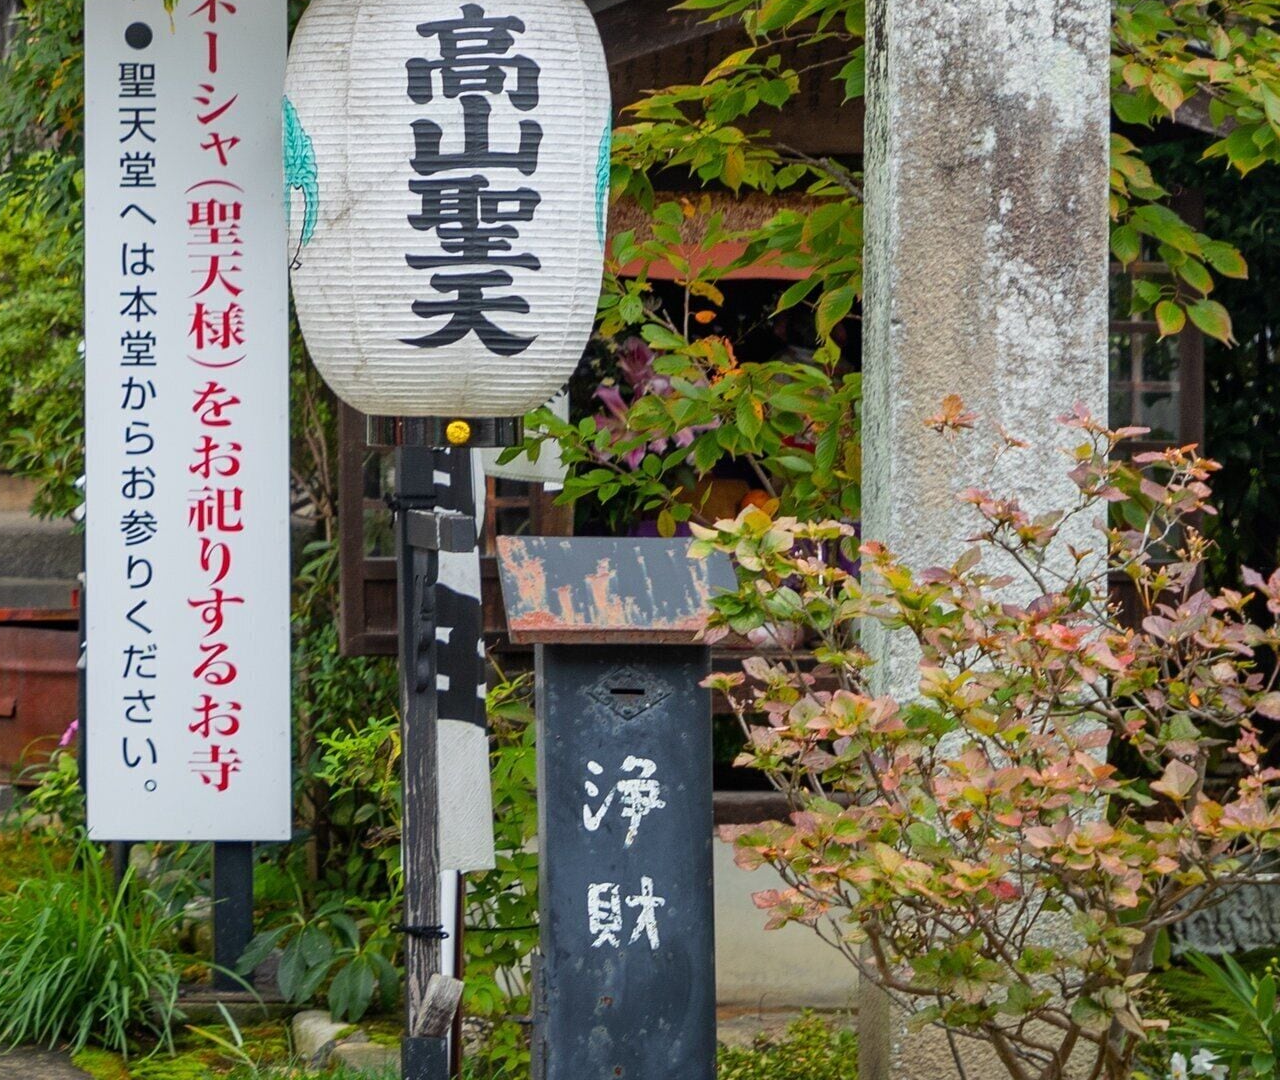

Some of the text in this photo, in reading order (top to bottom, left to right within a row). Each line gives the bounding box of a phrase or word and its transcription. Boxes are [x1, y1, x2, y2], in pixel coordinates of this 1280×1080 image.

[398, 3, 543, 356] 高山聖天
[583, 755, 667, 950] 浄財
